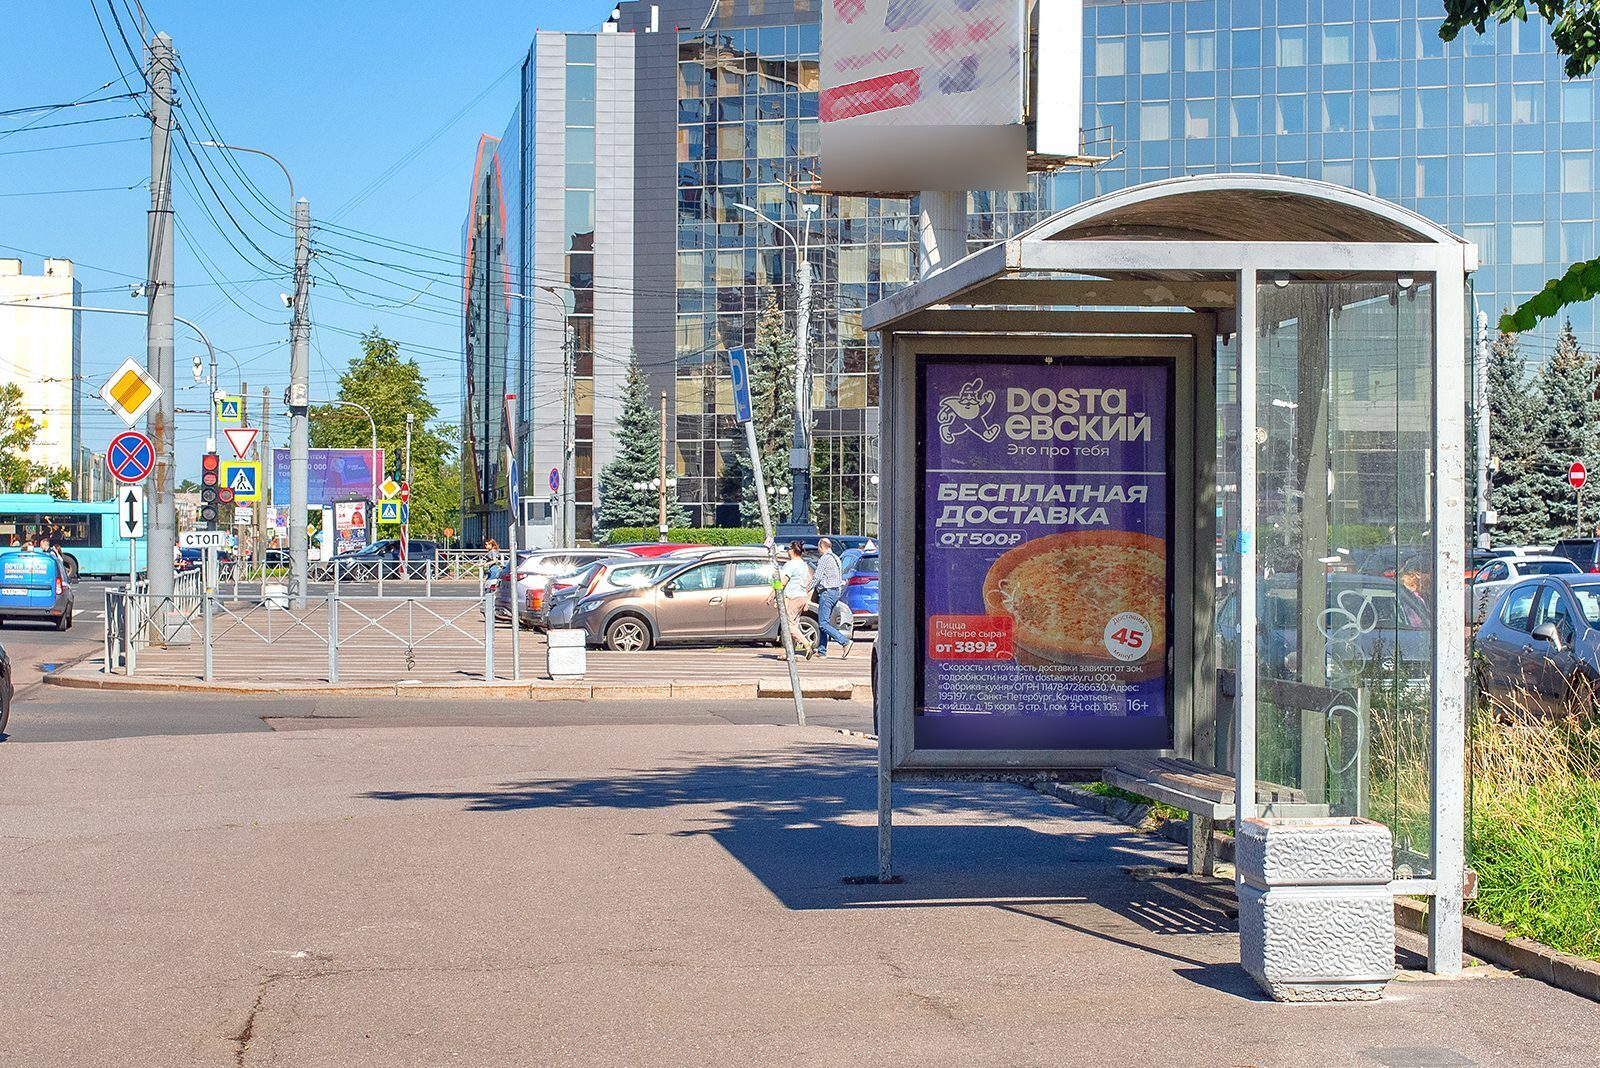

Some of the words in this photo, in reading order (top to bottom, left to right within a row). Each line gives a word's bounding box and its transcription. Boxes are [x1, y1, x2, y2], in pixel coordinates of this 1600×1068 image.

[1007, 444, 1036, 456] Это
[1041, 445, 1069, 458] про
[1073, 444, 1109, 457] тебя
[937, 483, 1148, 503] БЕСПЛАТНАЯ
[936, 506, 1109, 527] ДОСТАВКА
[186, 534, 219, 545] СТОП
[940, 533, 968, 545] ОТ
[969, 533, 1021, 545] 500₽
[936, 621, 966, 631] Пицца
[936, 630, 976, 639] «Четыре
[978, 631, 1006, 639] сыра»
[1111, 628, 1144, 648] 45
[935, 644, 952, 653] от
[954, 641, 997, 653] 389₽
[992, 664, 1037, 672] стоимость
[1038, 665, 1078, 674] доставки
[938, 673, 995, 682] подробности
[1009, 674, 1034, 682] сайте
[1035, 673, 1093, 683] dostaevsky.ru
[1095, 674, 1116, 682] ООО
[1014, 683, 1040, 691] ОГРН
[984, 702, 993, 710] 15
[1127, 699, 1149, 711] 16+
